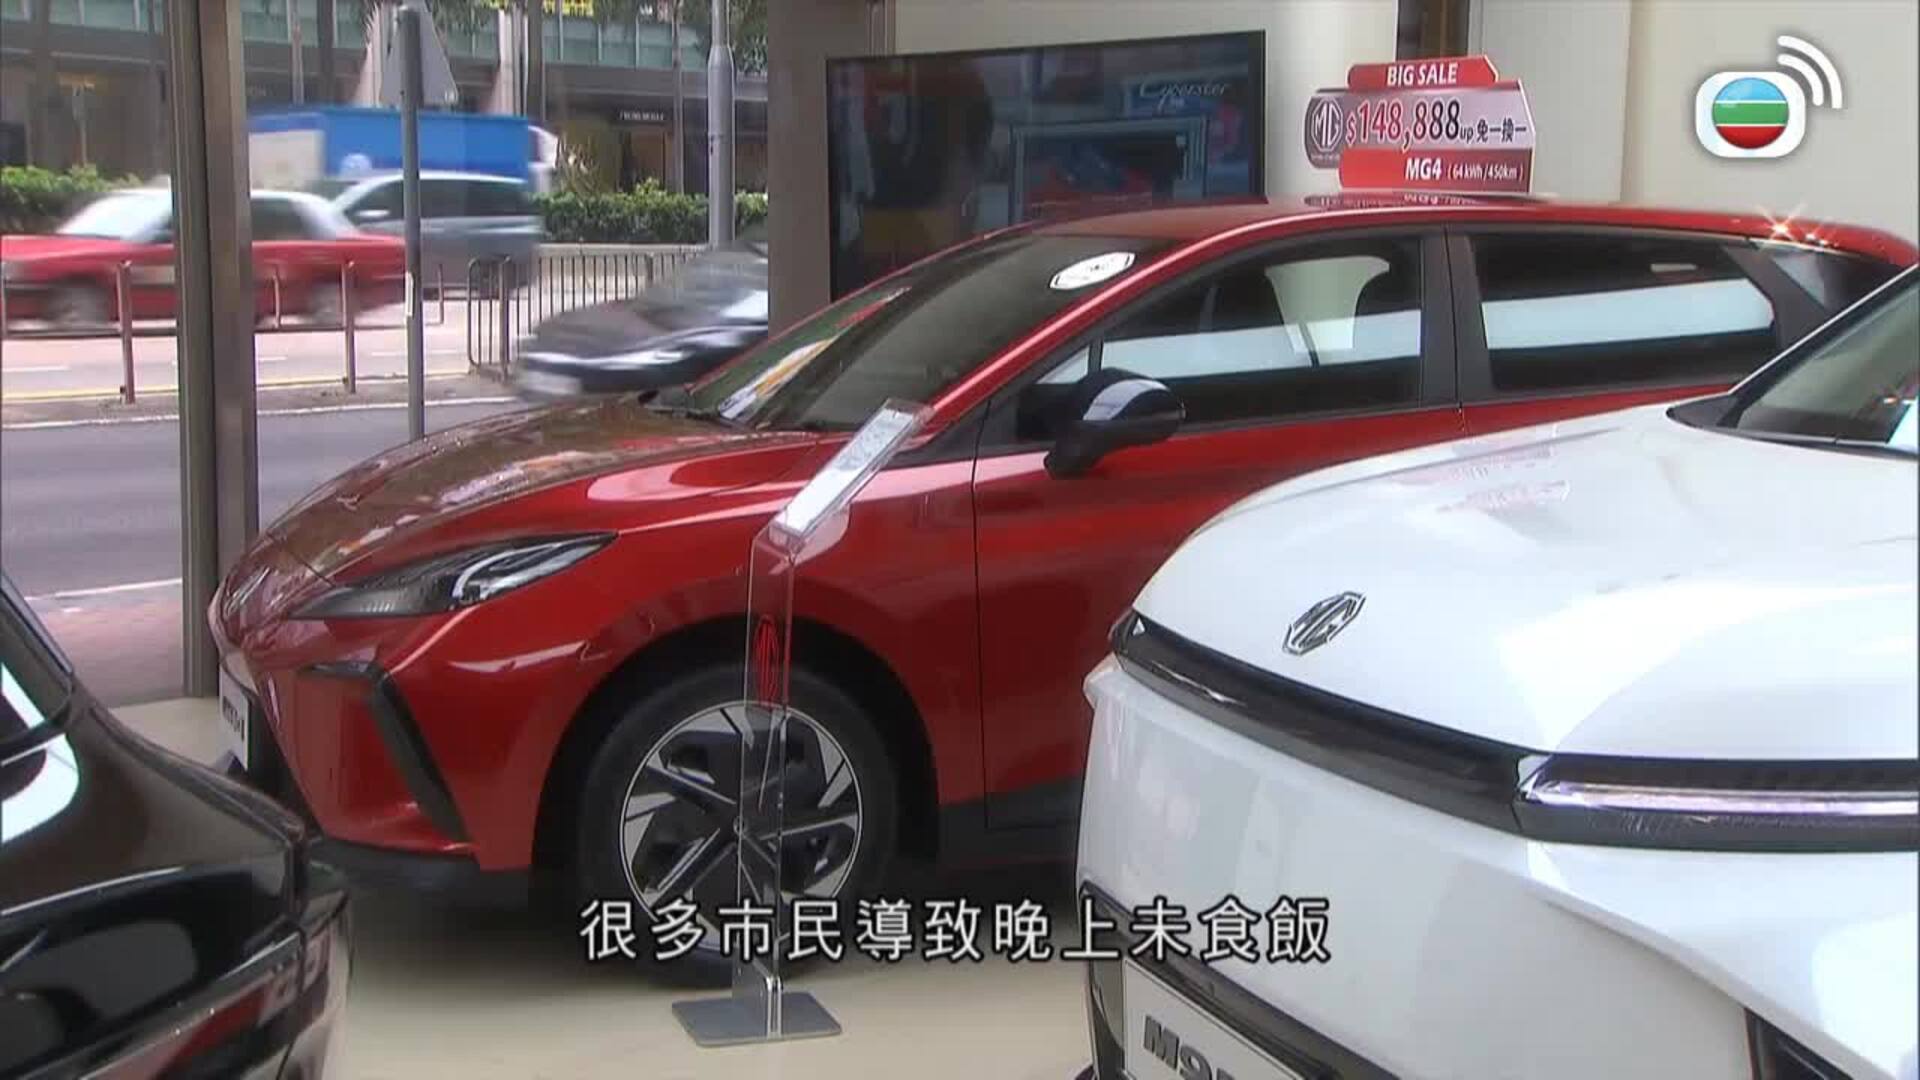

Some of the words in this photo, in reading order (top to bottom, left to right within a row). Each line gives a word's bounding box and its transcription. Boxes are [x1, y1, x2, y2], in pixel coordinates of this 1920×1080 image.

[1387, 64, 1414, 86] BIG
[1417, 61, 1458, 85] SALE
[1313, 100, 1341, 149] MG
[1405, 157, 1442, 181] MG4
[1284, 592, 1364, 655] MG
